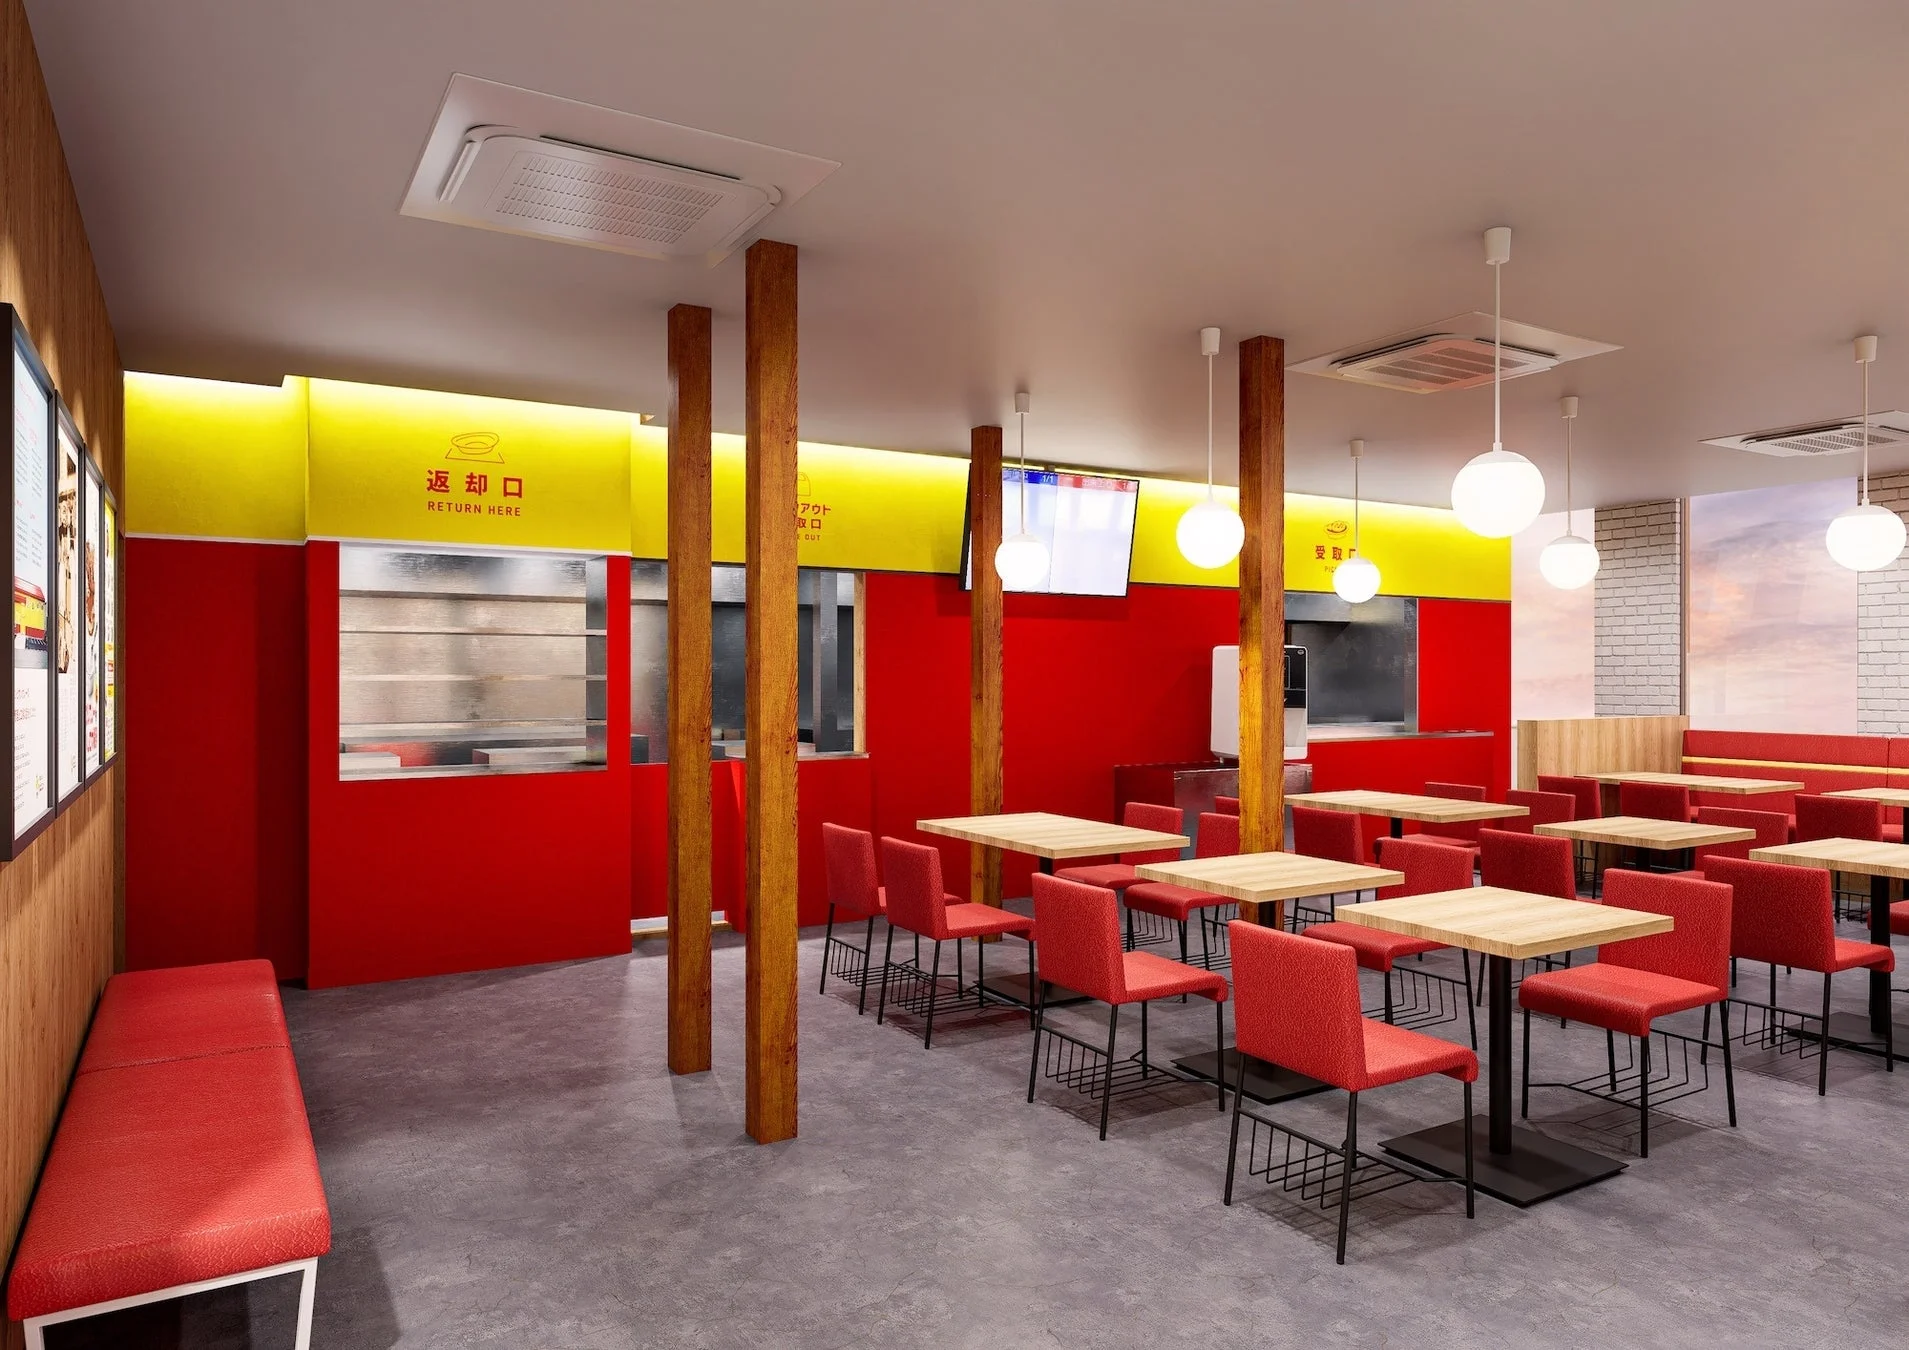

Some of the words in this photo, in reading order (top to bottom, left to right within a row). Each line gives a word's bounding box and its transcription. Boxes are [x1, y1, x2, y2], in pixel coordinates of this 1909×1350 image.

[427, 469, 522, 498] 返却口
[427, 500, 482, 514] RETURN
[488, 505, 521, 517] HERE
[797, 503, 831, 515] アウト
